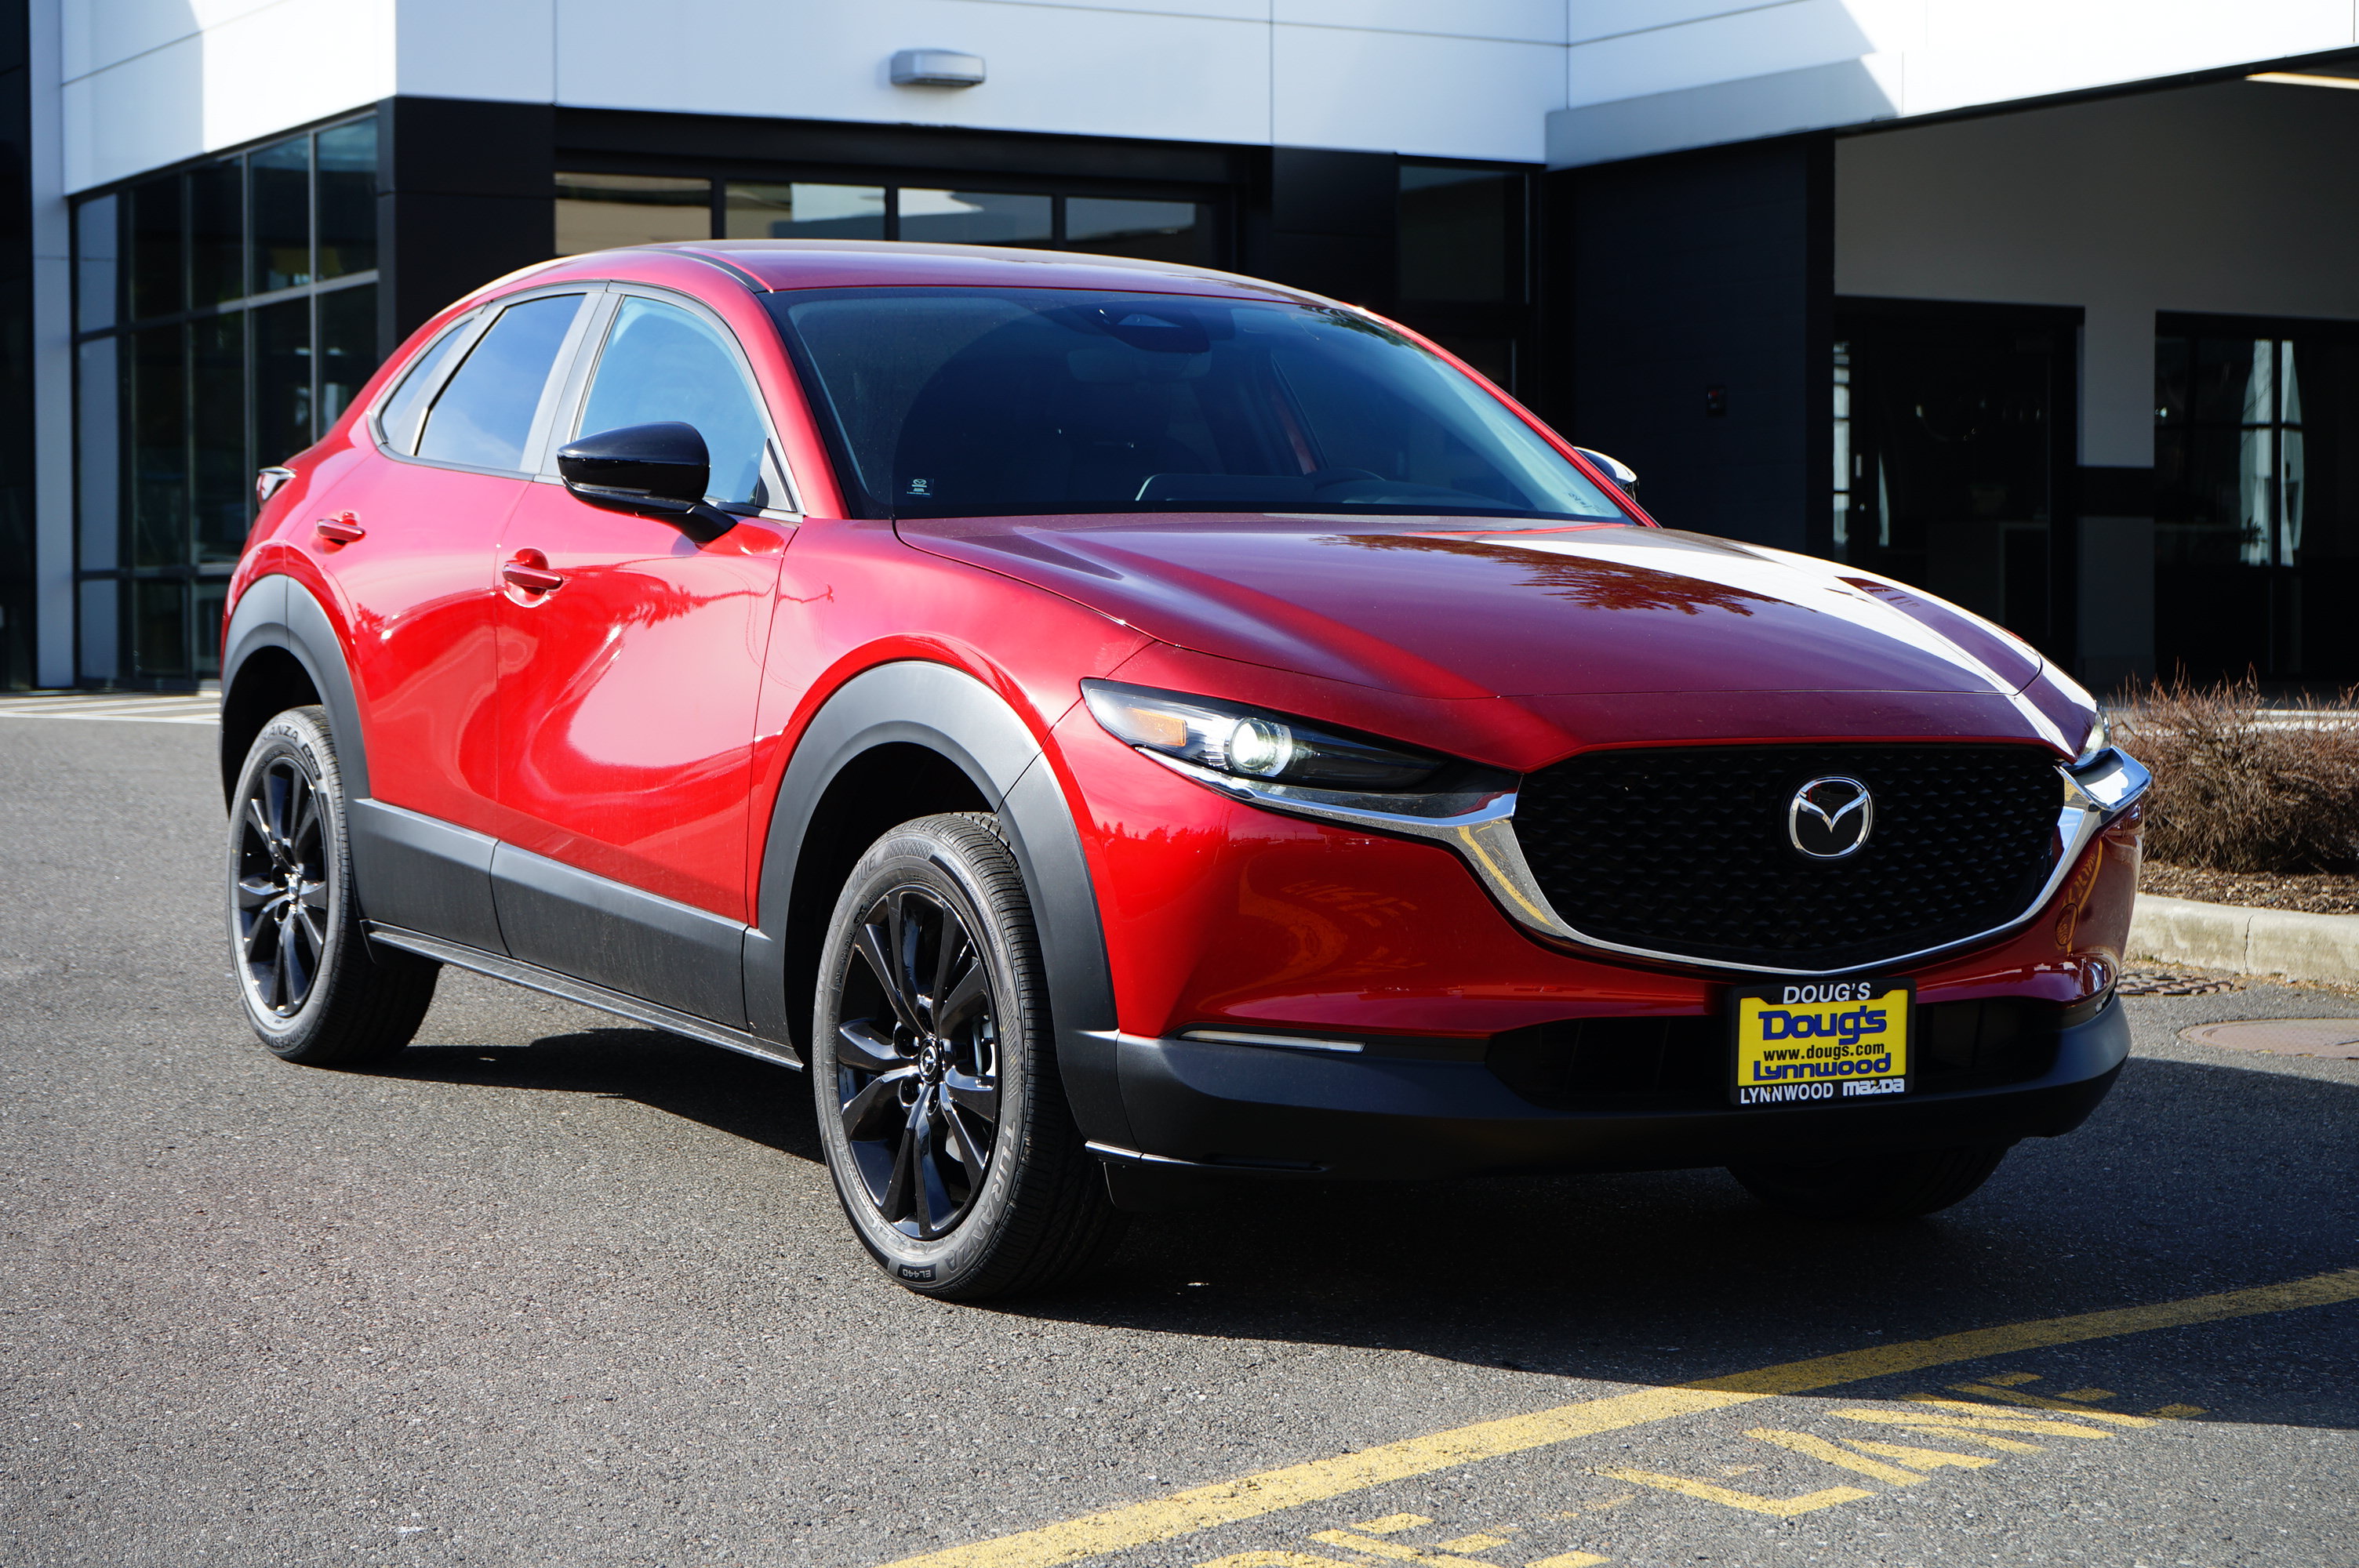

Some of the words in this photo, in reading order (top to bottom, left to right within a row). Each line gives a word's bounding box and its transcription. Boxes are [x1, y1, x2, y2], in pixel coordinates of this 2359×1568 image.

[1783, 982, 1871, 1004] DOUG'S
[1763, 1043, 1885, 1062] www.dougs.com
[1754, 1053, 1892, 1081] Lynnwood
[1740, 1083, 1834, 1104] LYNNWOOD
[944, 1121, 1016, 1273] TURANZA
